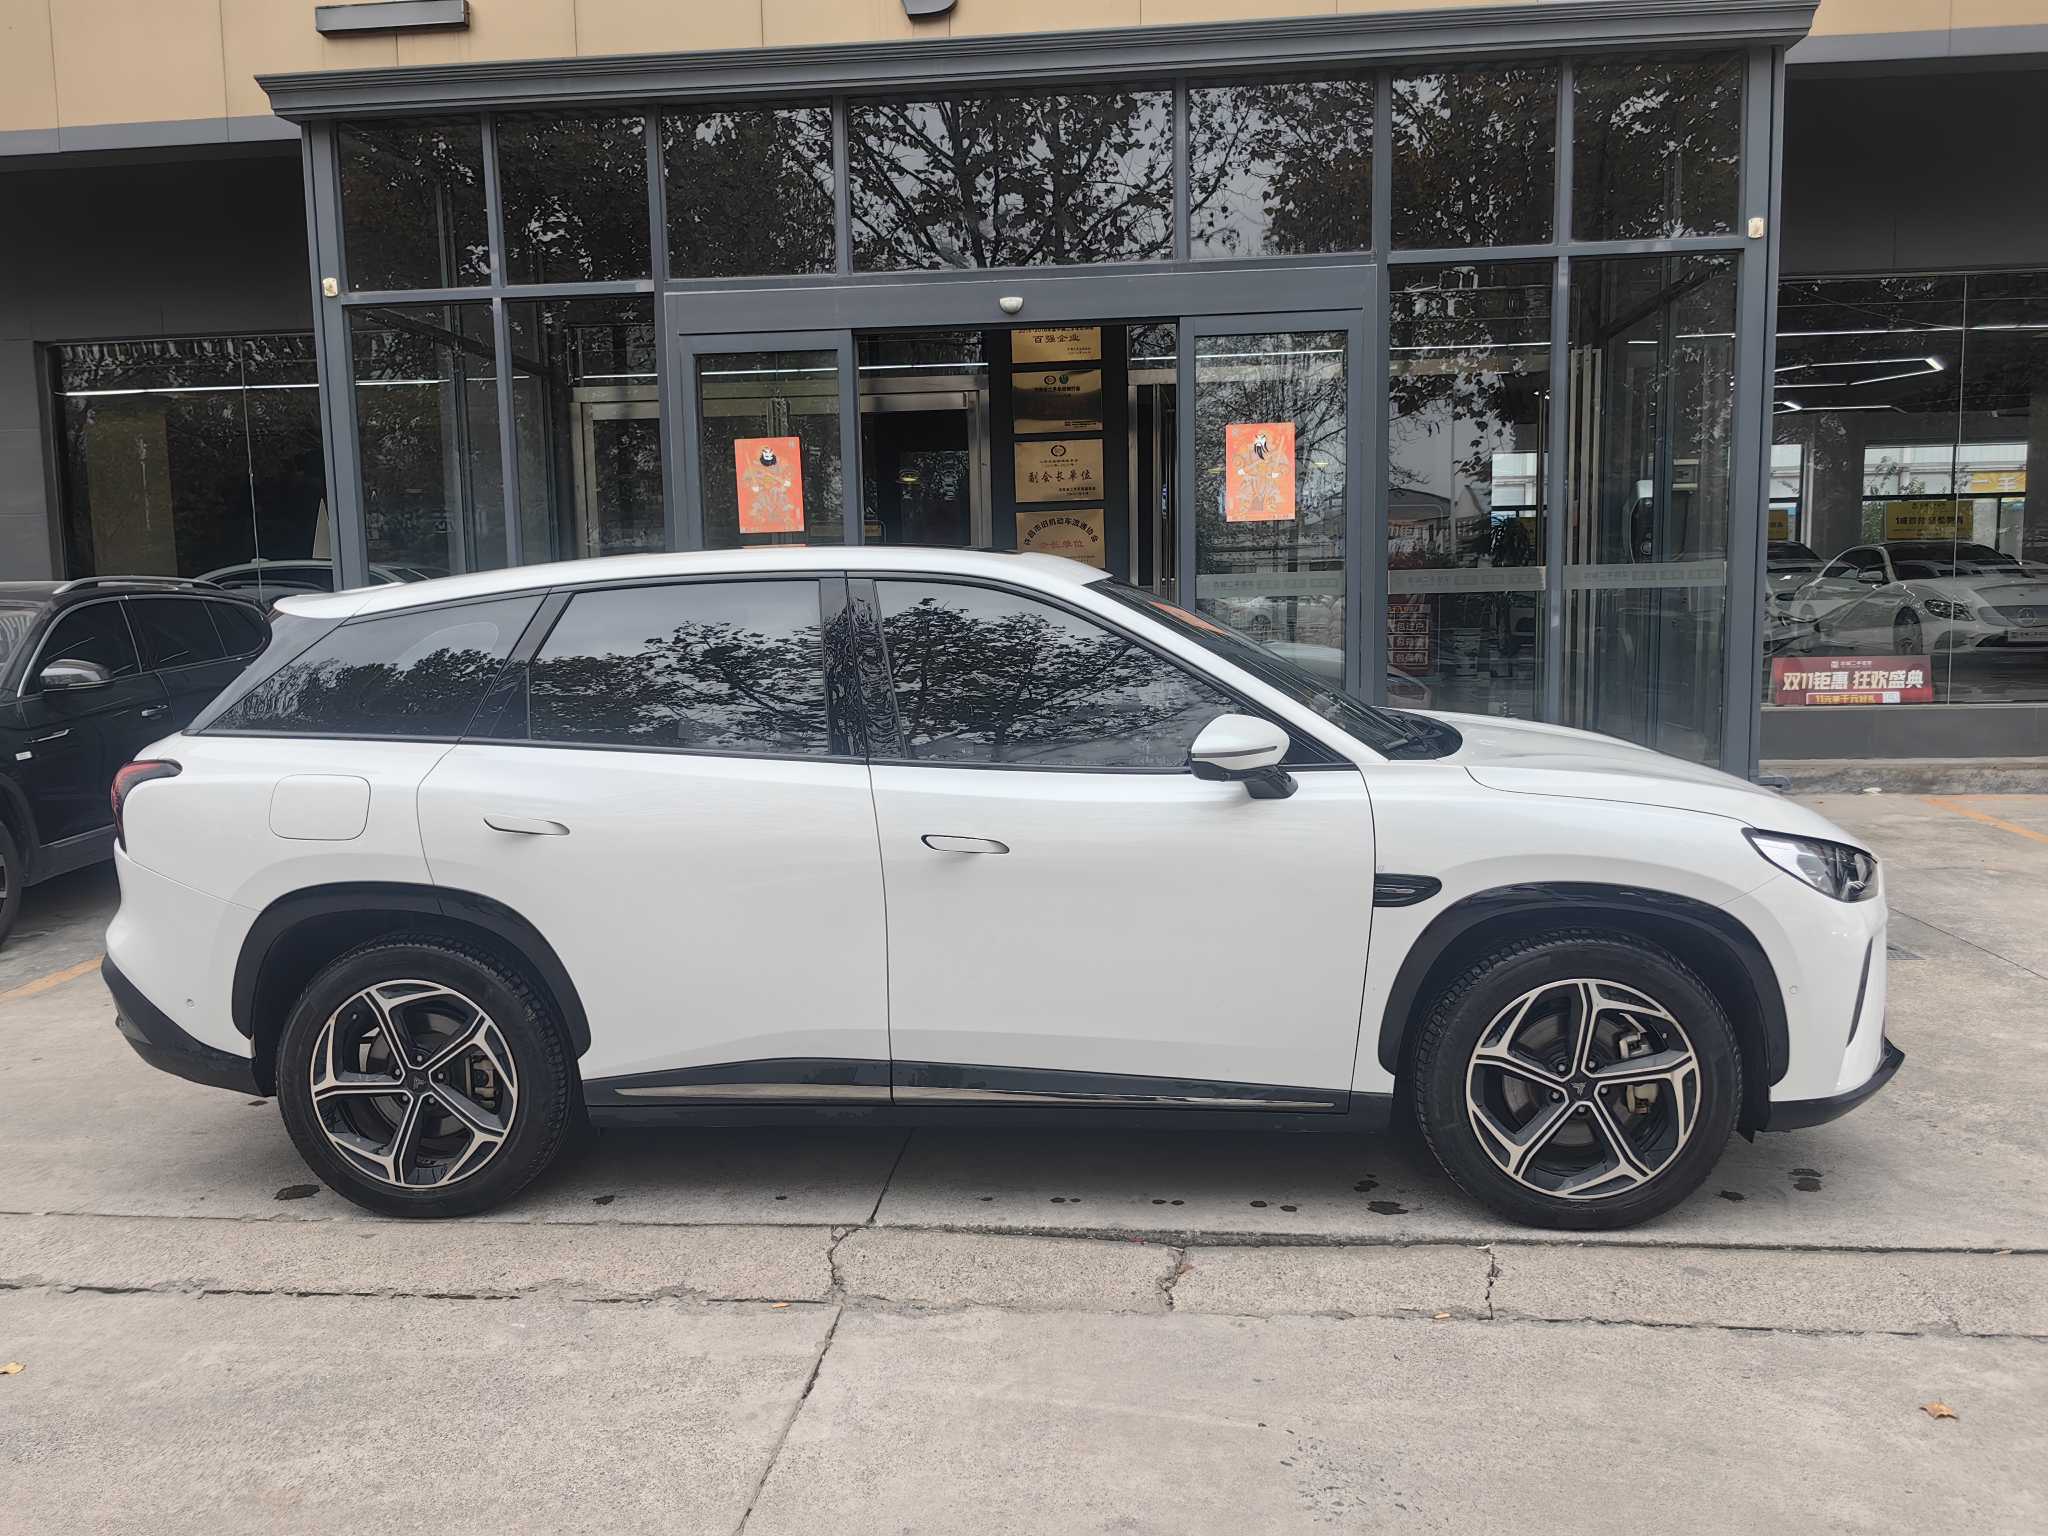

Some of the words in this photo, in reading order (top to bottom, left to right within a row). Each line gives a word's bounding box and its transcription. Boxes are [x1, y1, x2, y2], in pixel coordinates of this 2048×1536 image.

[1032, 333, 1081, 344] 百强企业
[1028, 468, 1093, 484] 副会长单位
[1852, 669, 1925, 690] 狂欢盛典
